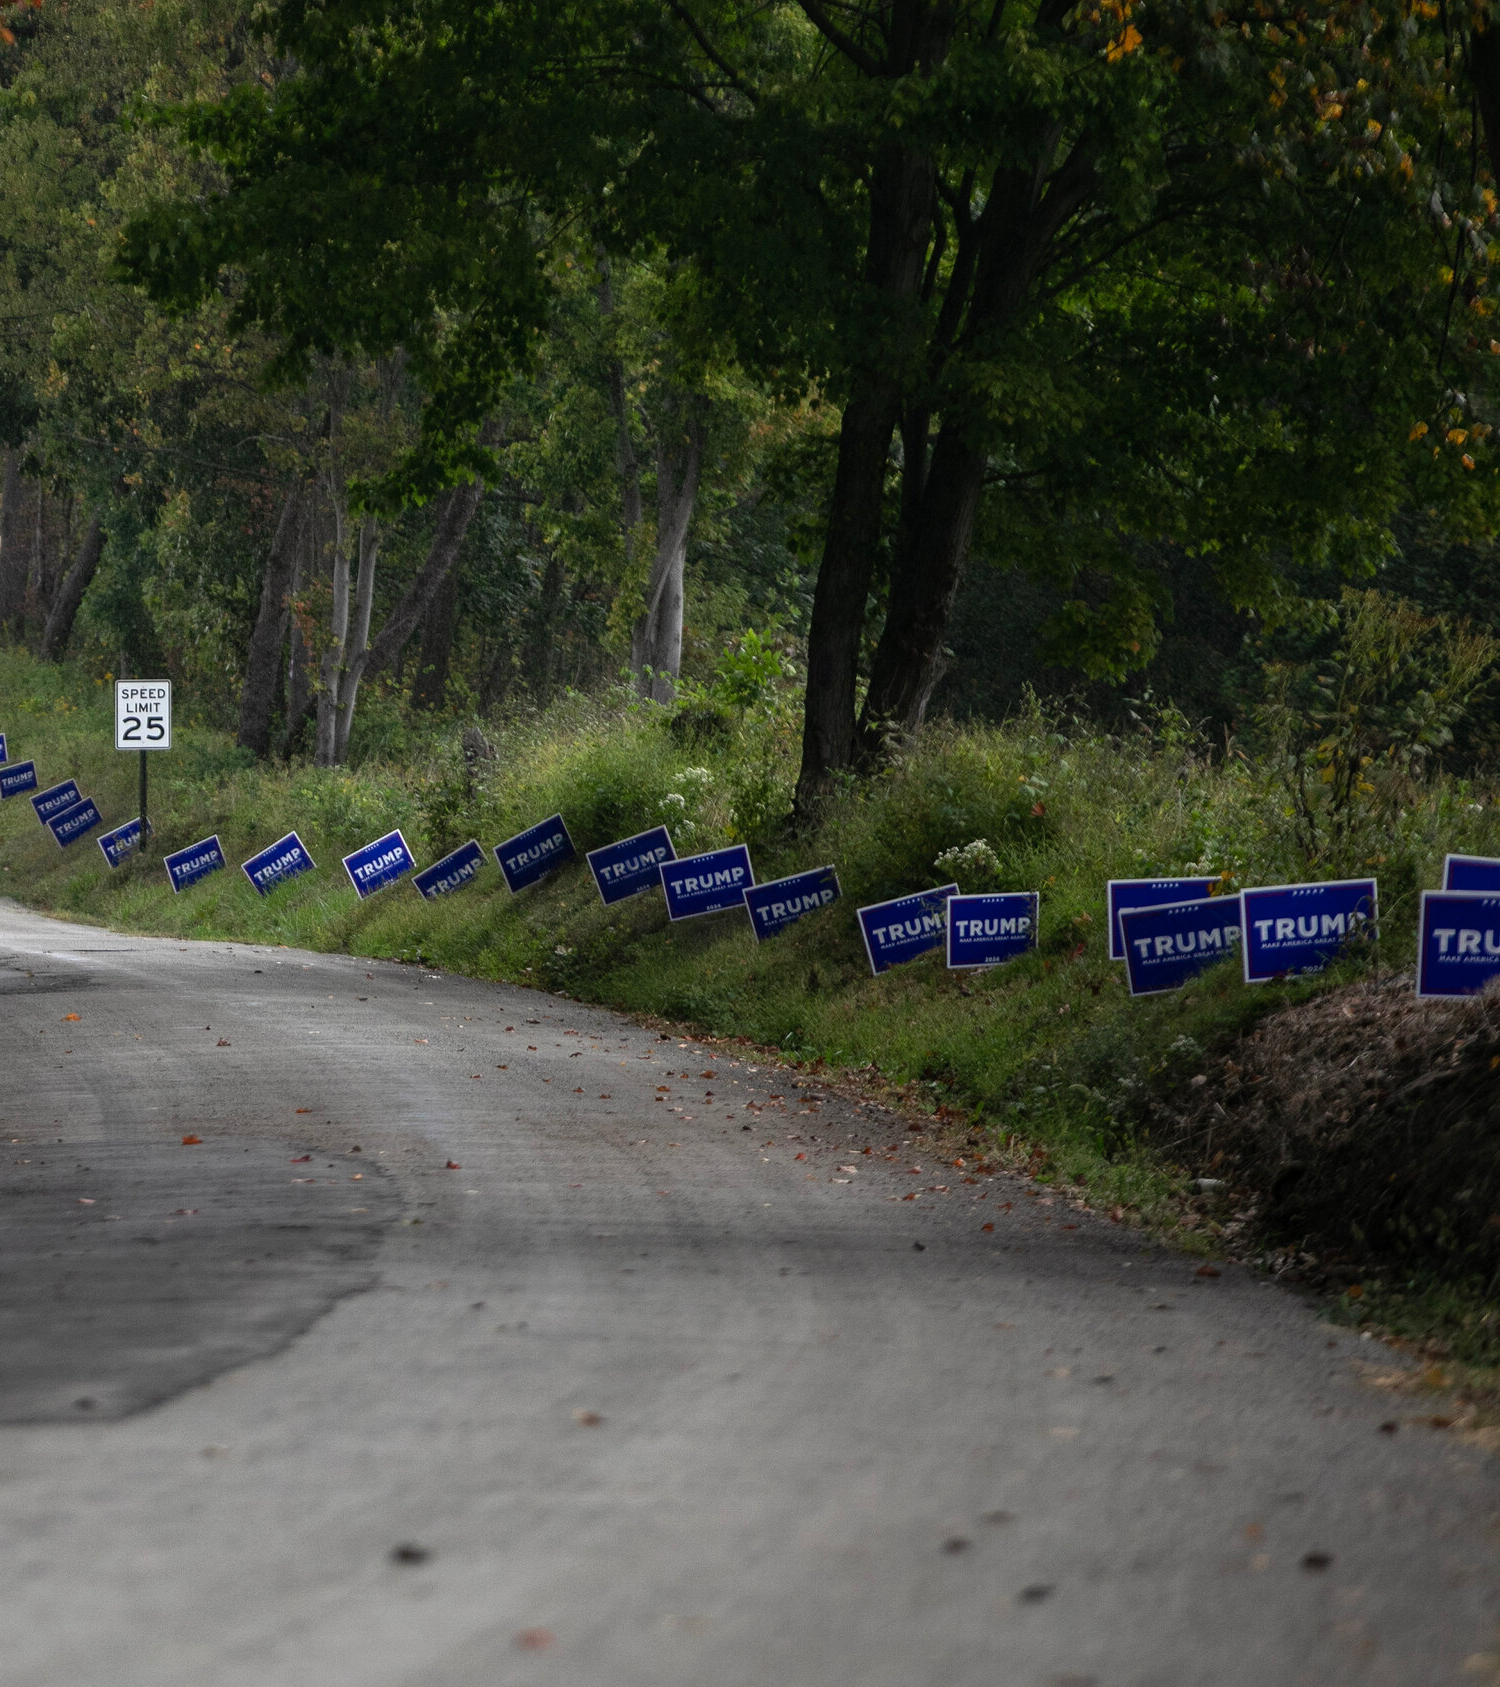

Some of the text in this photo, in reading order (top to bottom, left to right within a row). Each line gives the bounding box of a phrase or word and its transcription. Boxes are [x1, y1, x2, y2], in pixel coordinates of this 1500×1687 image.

[121, 689, 166, 699] SPEED
[126, 703, 160, 712] LIMIT
[122, 717, 165, 740] 25
[2, 771, 33, 787] TRUMP
[38, 790, 76, 813] TRUMP
[56, 808, 96, 836] TRUMP
[173, 850, 218, 876] TRUMP
[253, 846, 300, 883] TRUMP
[354, 847, 404, 881] TRUMP
[506, 832, 564, 871] TRUMP
[600, 846, 667, 881] TRUMP
[426, 858, 483, 896] TRUMP
[670, 866, 746, 895] TRUMP
[756, 889, 835, 922] TRUMP
[956, 916, 1033, 938] TRUMP
[1133, 925, 1241, 959] TRUMP
[1432, 927, 1500, 957] TRU
